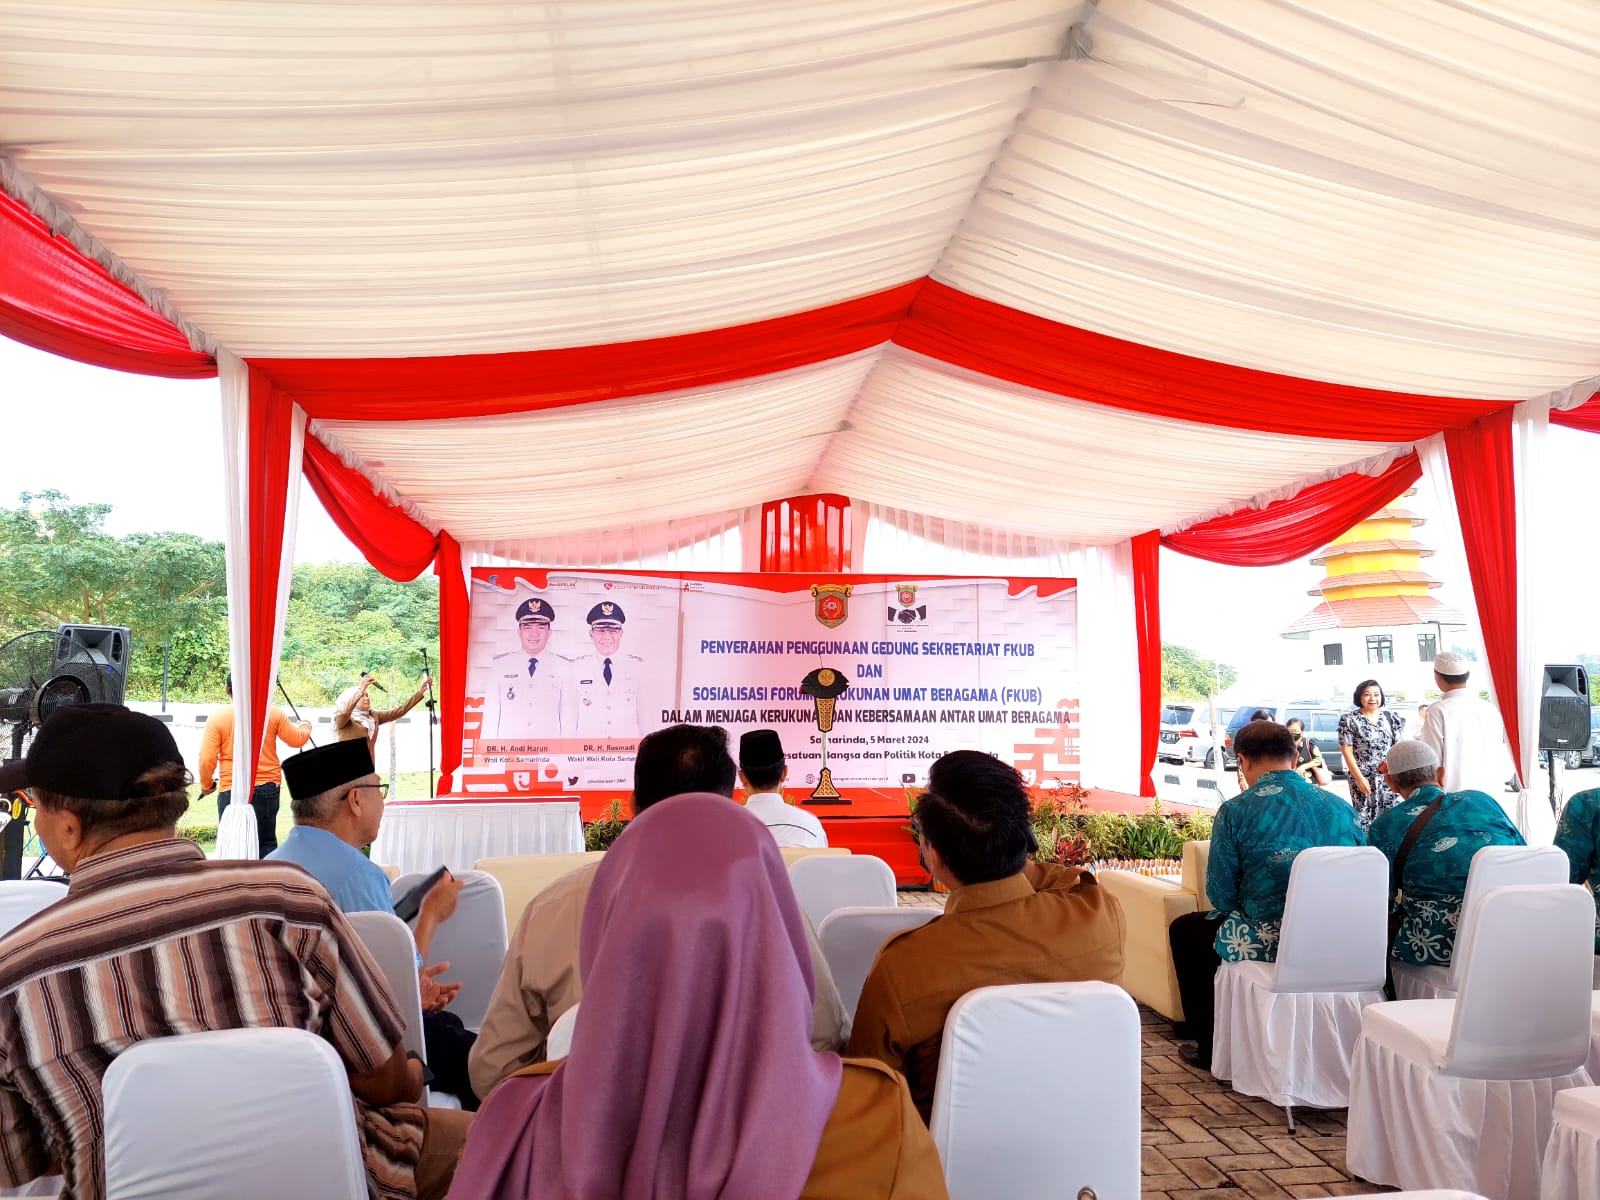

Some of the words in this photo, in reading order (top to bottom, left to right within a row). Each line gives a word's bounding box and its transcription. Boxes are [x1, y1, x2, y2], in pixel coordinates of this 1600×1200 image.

[701, 640, 783, 654] PENYERAHAN
[787, 641, 868, 655] PENGGUNAAN
[872, 641, 919, 655] GEDUNG
[922, 642, 1000, 656] SEKRETARIAT
[1003, 643, 1035, 656] FKUB
[857, 664, 882, 678] DAN
[693, 687, 768, 701] SOSIALISASI
[835, 687, 889, 701] UKUNAN
[893, 687, 927, 701] UMAT
[931, 688, 998, 702] BERAGAMA
[1001, 686, 1042, 705] (FKUB)
[661, 709, 702, 723] DALAM
[705, 709, 757, 723] MENJAGA
[760, 709, 818, 723] KERUKUNA
[855, 709, 936, 723] KEBERSAMAAN
[940, 710, 975, 723] ANTAR
[978, 710, 1008, 723] UMAT
[1011, 710, 1071, 724] BERAGAMA
[809, 735, 869, 746] Saarinda,
[870, 736, 876, 744] 5
[877, 735, 906, 744] Maret
[907, 736, 929, 744] 2024
[584, 744, 596, 752] DR.
[606, 744, 635, 752] Rusmadi
[784, 750, 821, 760] satuan
[863, 751, 882, 760] dan
[884, 751, 916, 760] Politik
[919, 751, 943, 760] Kota
